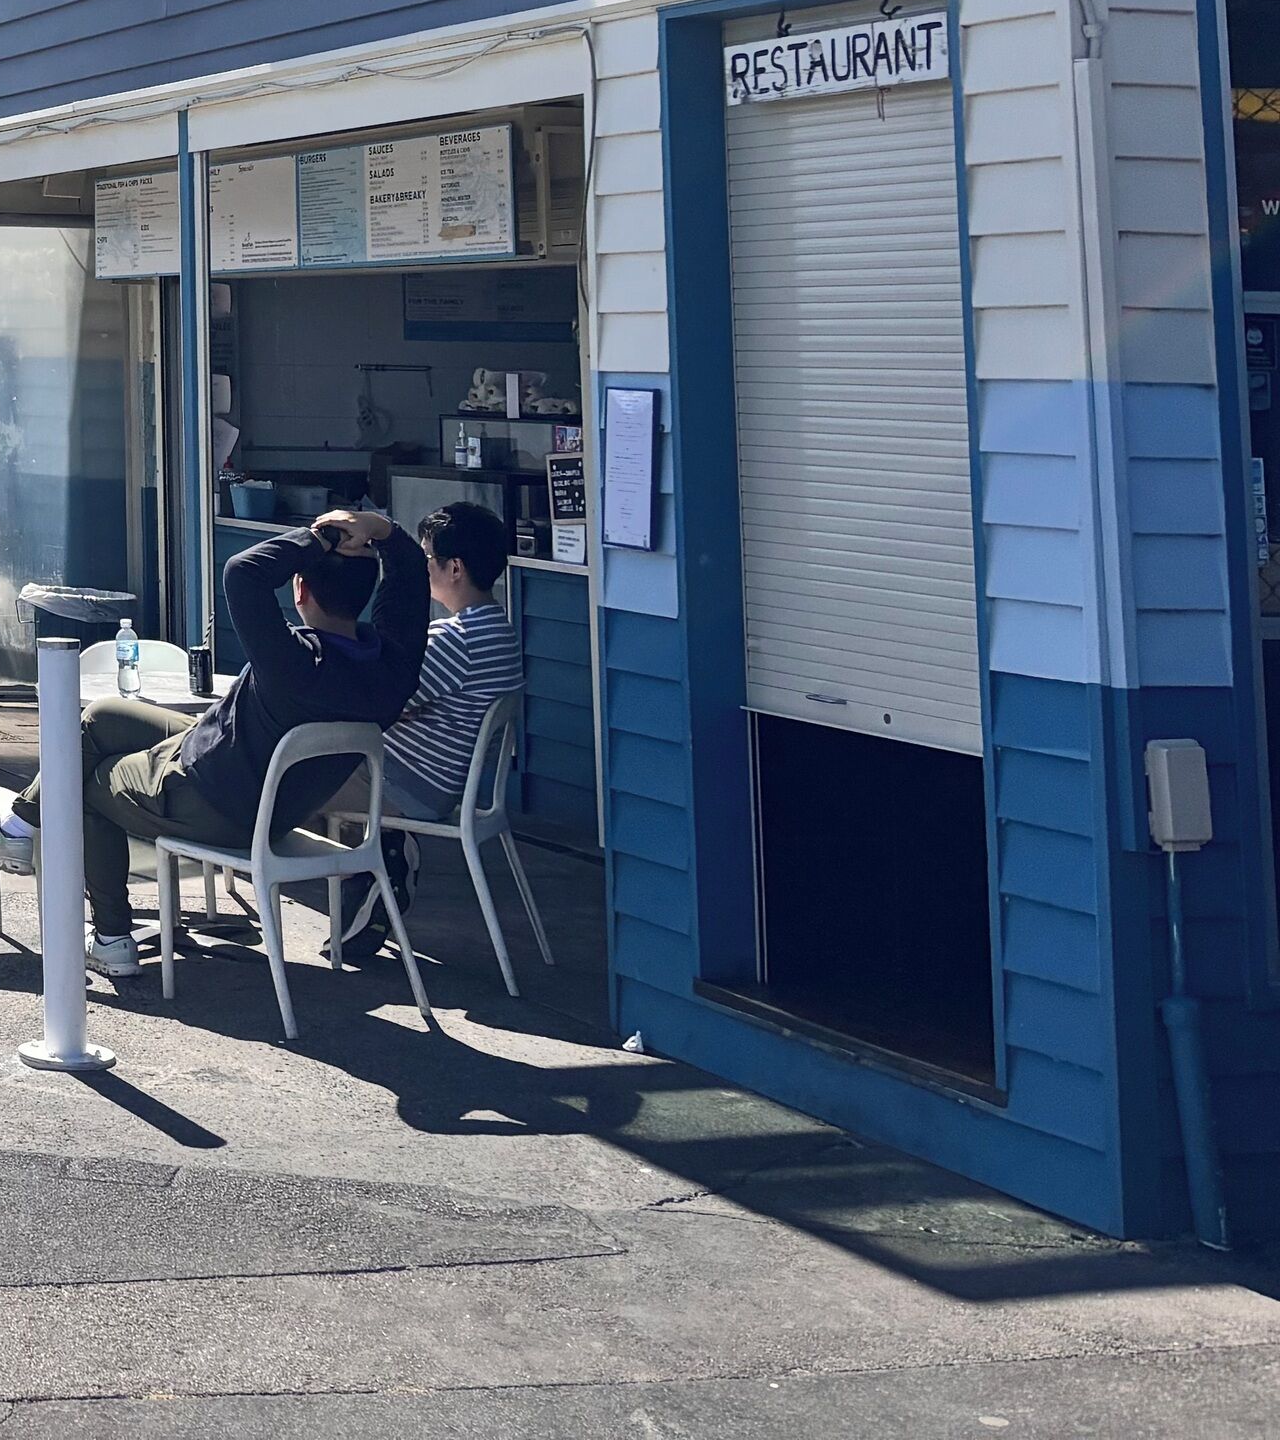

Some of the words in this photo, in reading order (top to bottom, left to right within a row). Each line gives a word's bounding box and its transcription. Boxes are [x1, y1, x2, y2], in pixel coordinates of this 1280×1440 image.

[731, 21, 943, 98] RESTAURANT
[439, 132, 481, 146] BEVERAGES
[368, 143, 394, 156] SAUCES
[300, 153, 327, 165] BURGERS
[369, 167, 395, 180] SALADS
[369, 190, 427, 205] BAKERY&BREAKY
